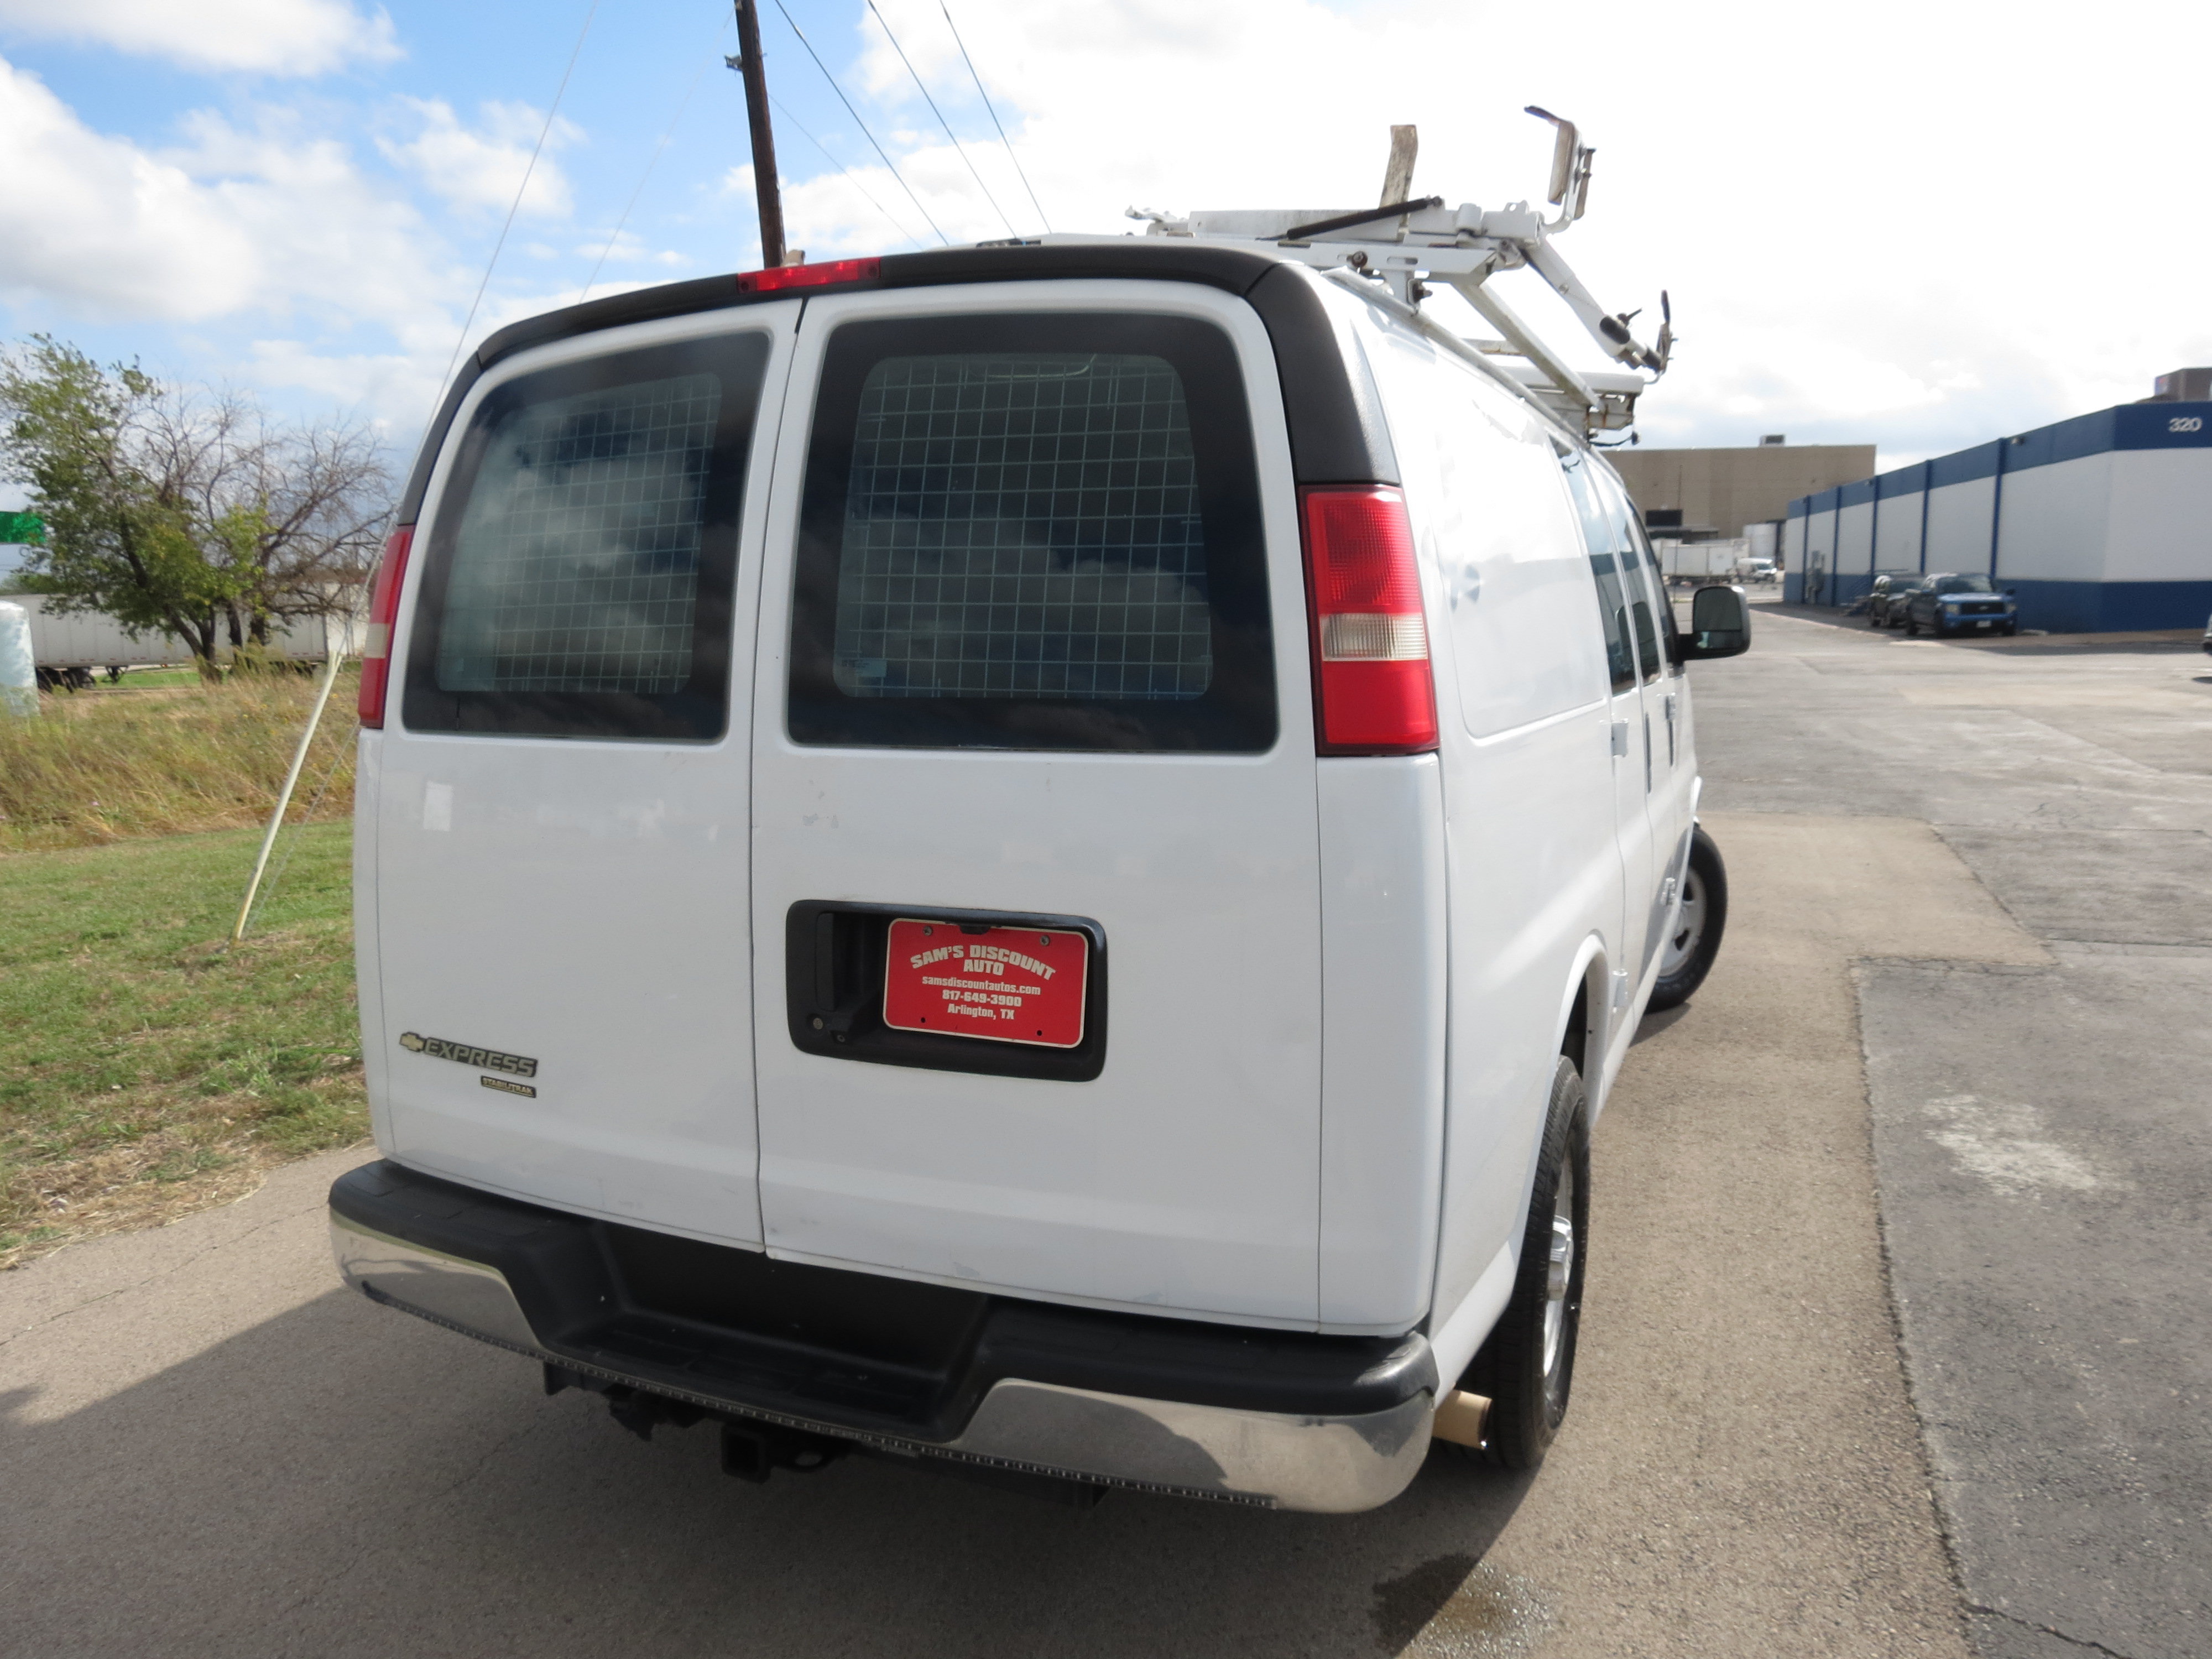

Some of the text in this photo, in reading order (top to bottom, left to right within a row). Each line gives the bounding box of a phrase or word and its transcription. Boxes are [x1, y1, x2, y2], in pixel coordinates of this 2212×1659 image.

[2169, 418, 2203, 431] 320
[910, 945, 1056, 980] SAM'S DISCOUNT
[963, 959, 1005, 976] AUTO
[922, 976, 1041, 995] samsdiscountautos.com
[942, 990, 1022, 1007] 817-649-3900
[947, 1004, 1015, 1020] Arlington, TX
[423, 1037, 535, 1078] EXPRESS
